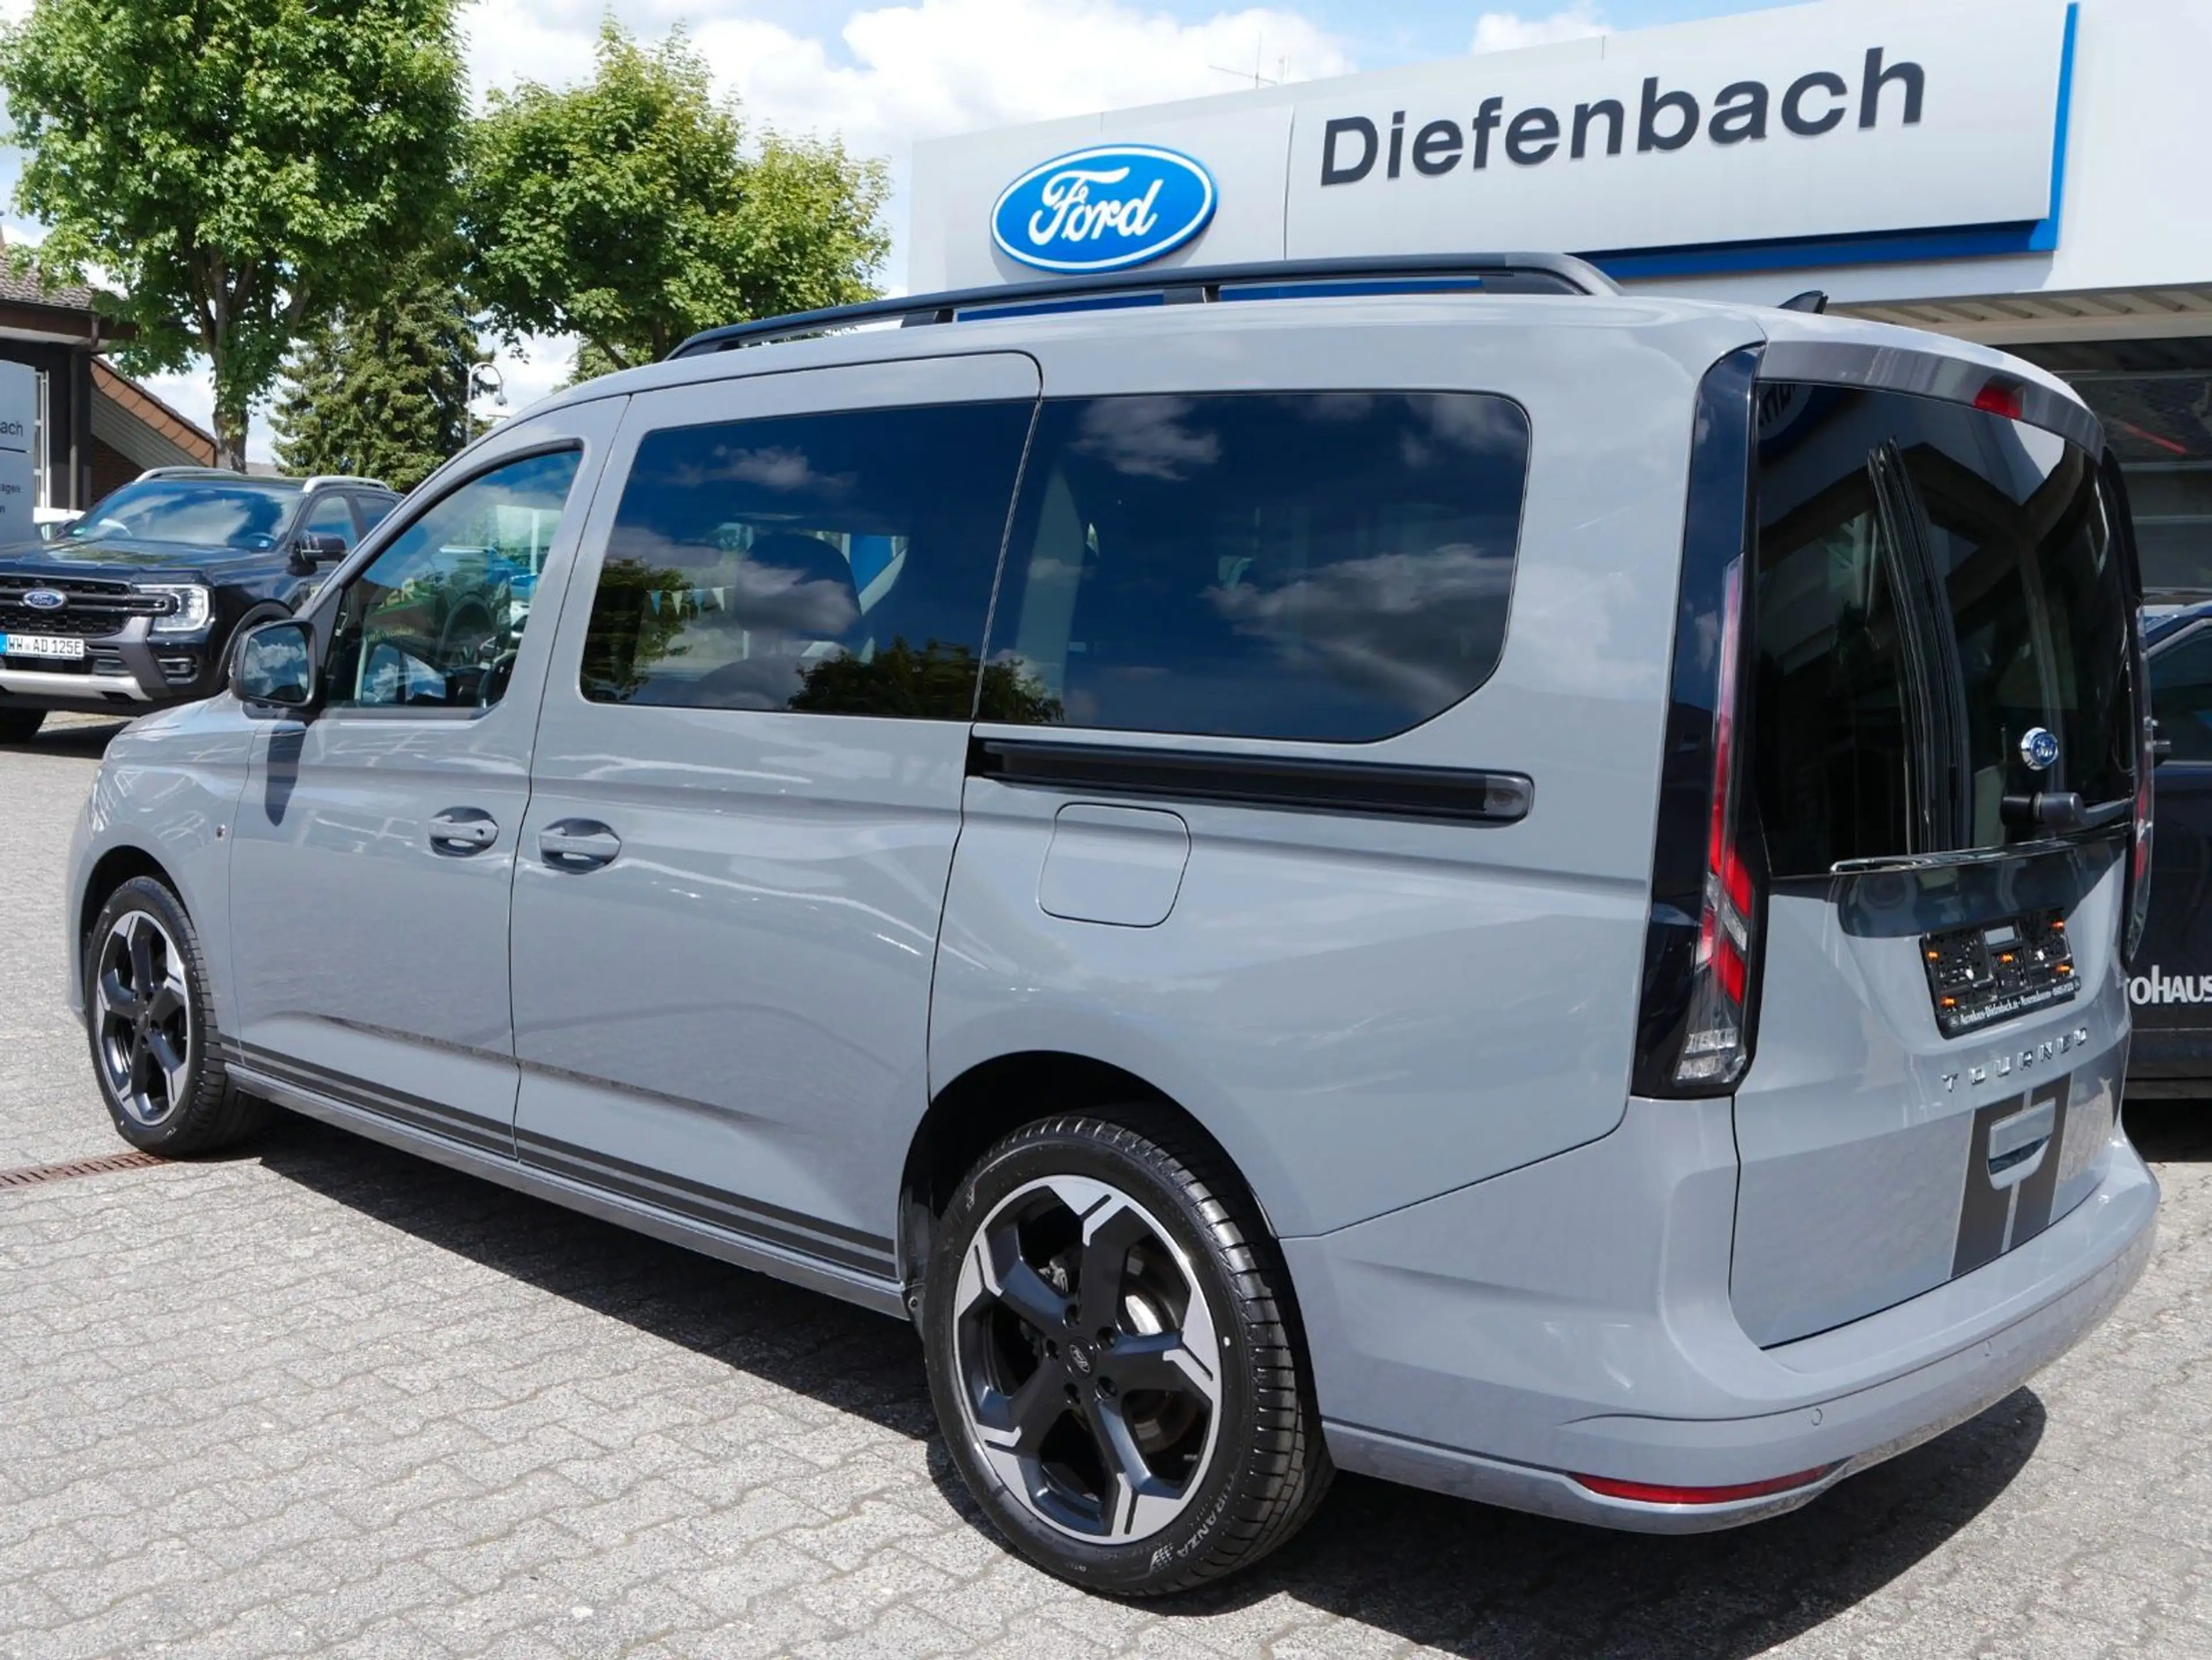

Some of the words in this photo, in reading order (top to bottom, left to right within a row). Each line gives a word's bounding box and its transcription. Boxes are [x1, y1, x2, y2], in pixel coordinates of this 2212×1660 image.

[1321, 46, 1925, 186] Diefenbach
[1028, 167, 1163, 246] Ford
[33, 639, 48, 652] AD
[52, 640, 81, 655] 125E
[2125, 965, 2212, 1005] OHAUS
[1940, 1028, 2087, 1093] TOURNEO
